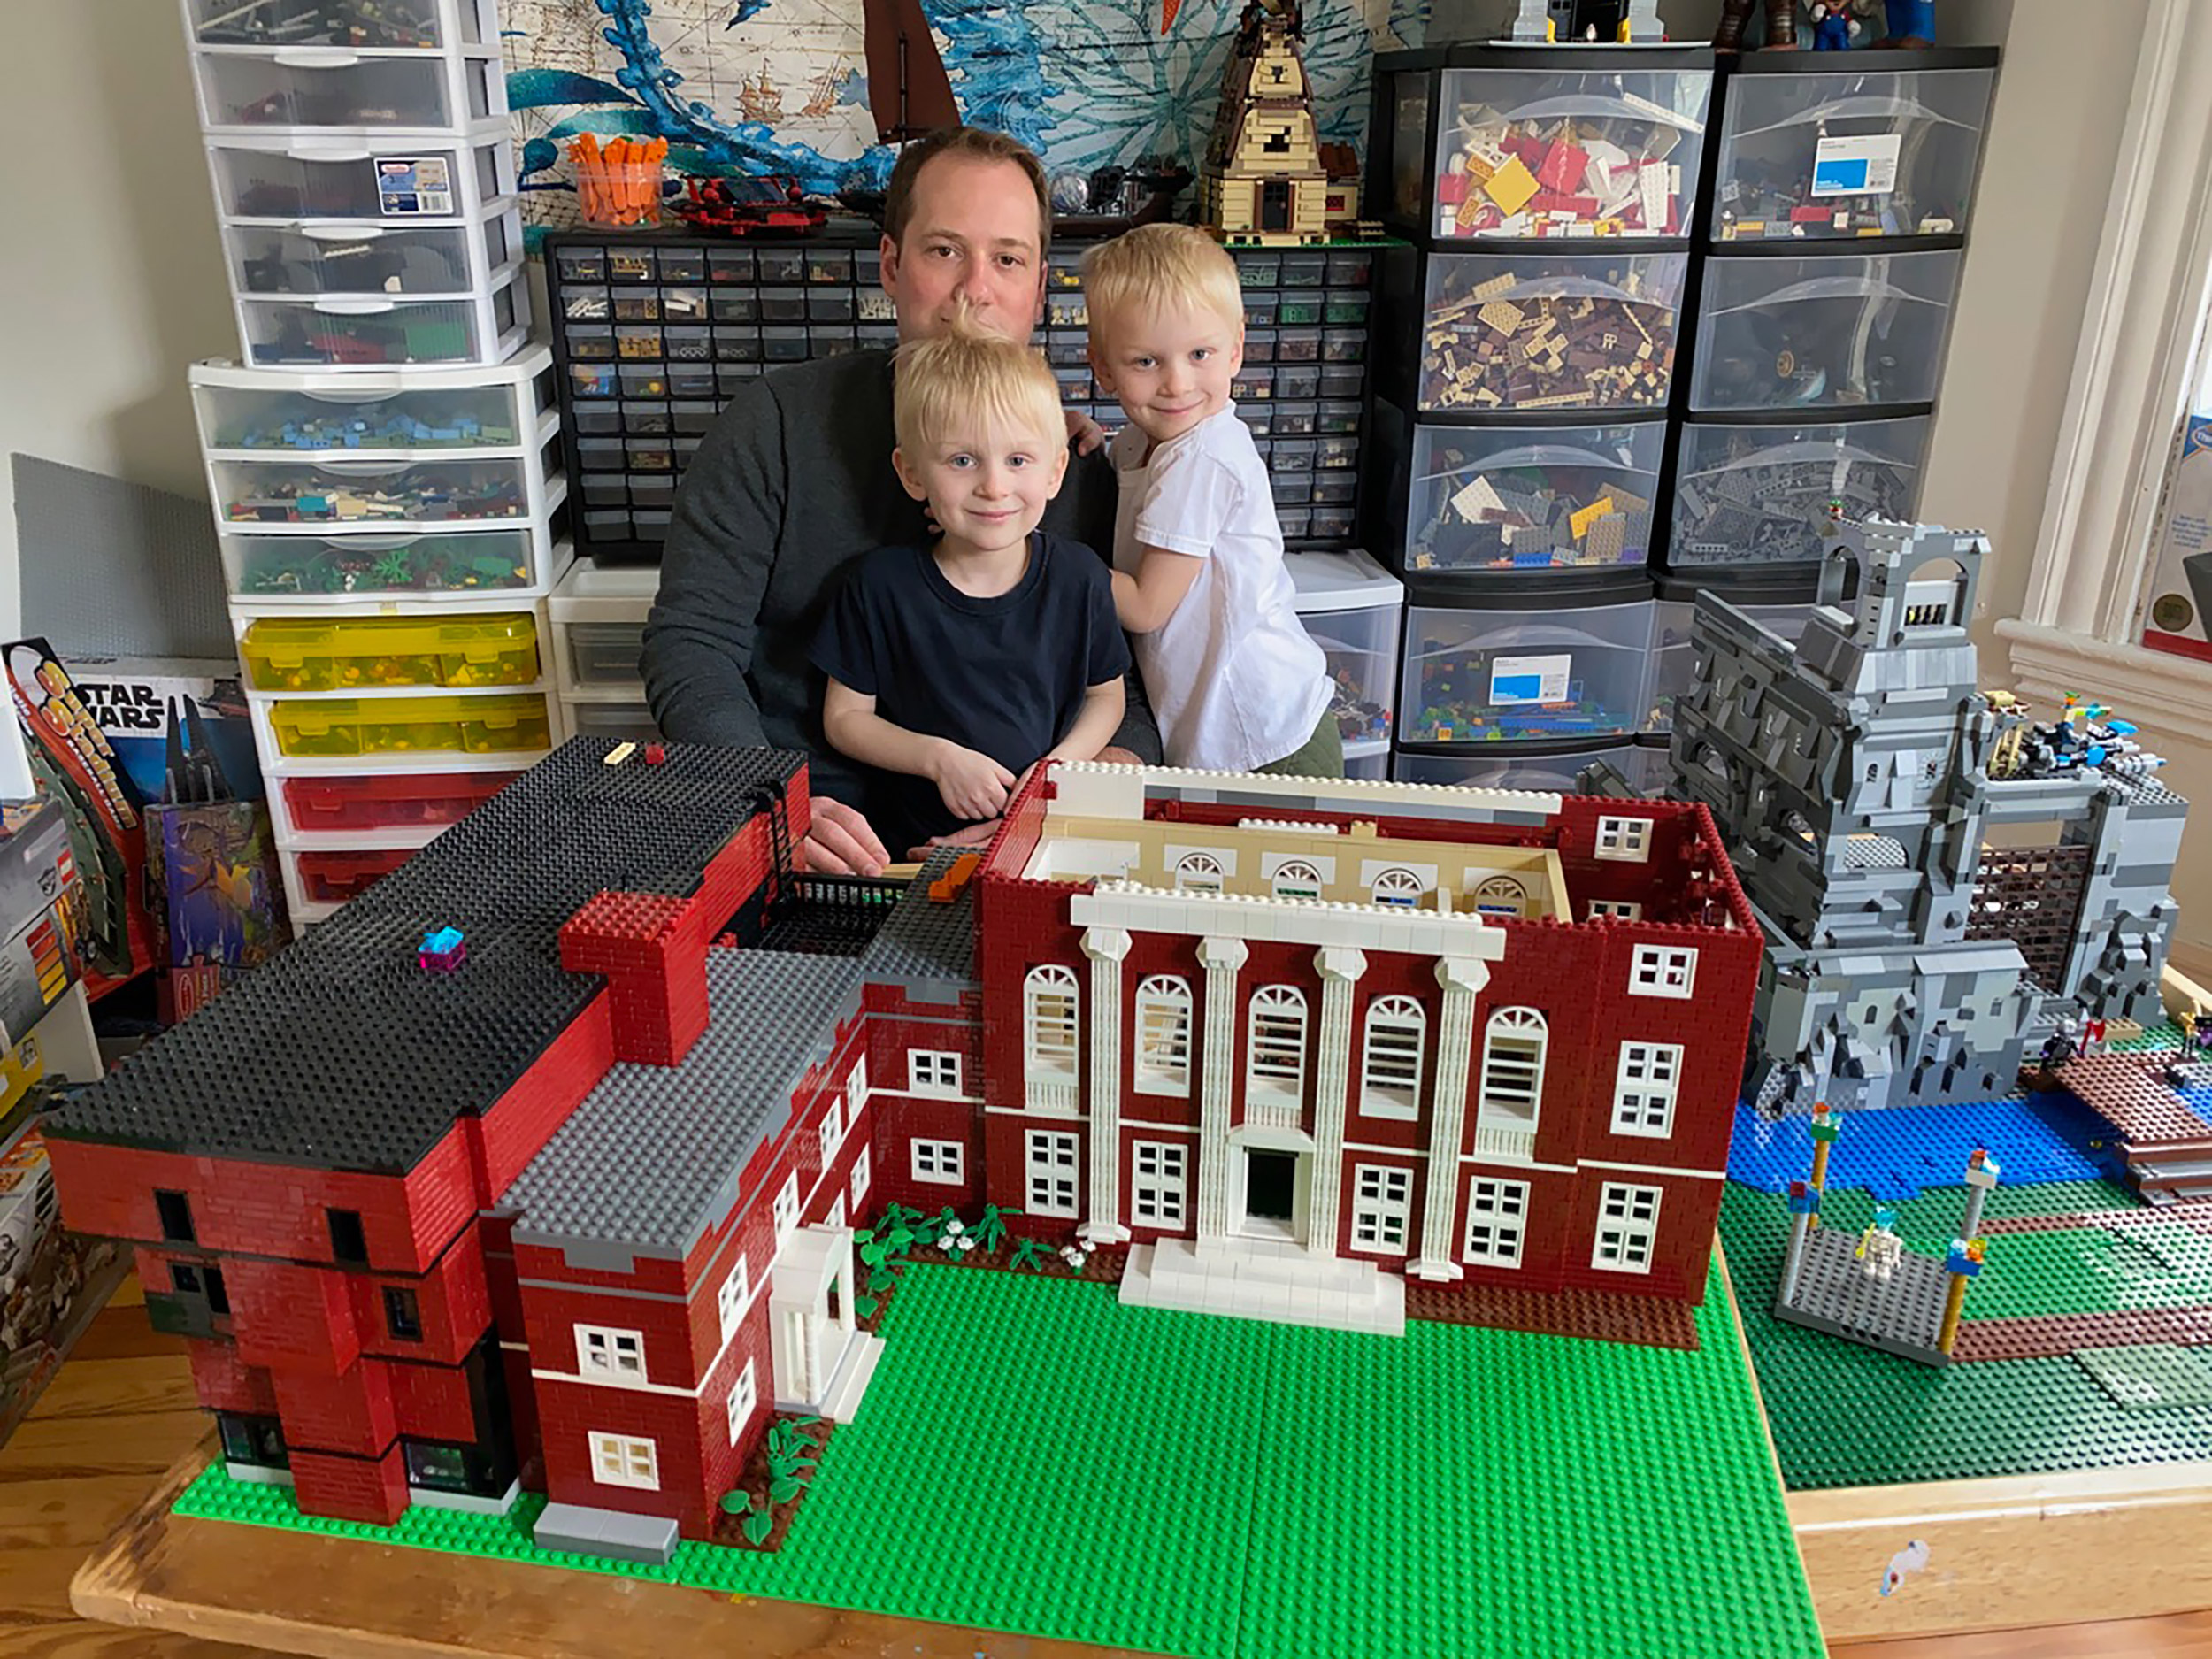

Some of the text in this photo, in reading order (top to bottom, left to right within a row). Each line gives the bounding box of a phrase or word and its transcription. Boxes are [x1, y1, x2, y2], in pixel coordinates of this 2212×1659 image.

[35, 660, 116, 757] Super
[76, 683, 163, 706] STAR
[40, 696, 137, 829] Stadium
[65, 738, 124, 831] BASEBALL GAME
